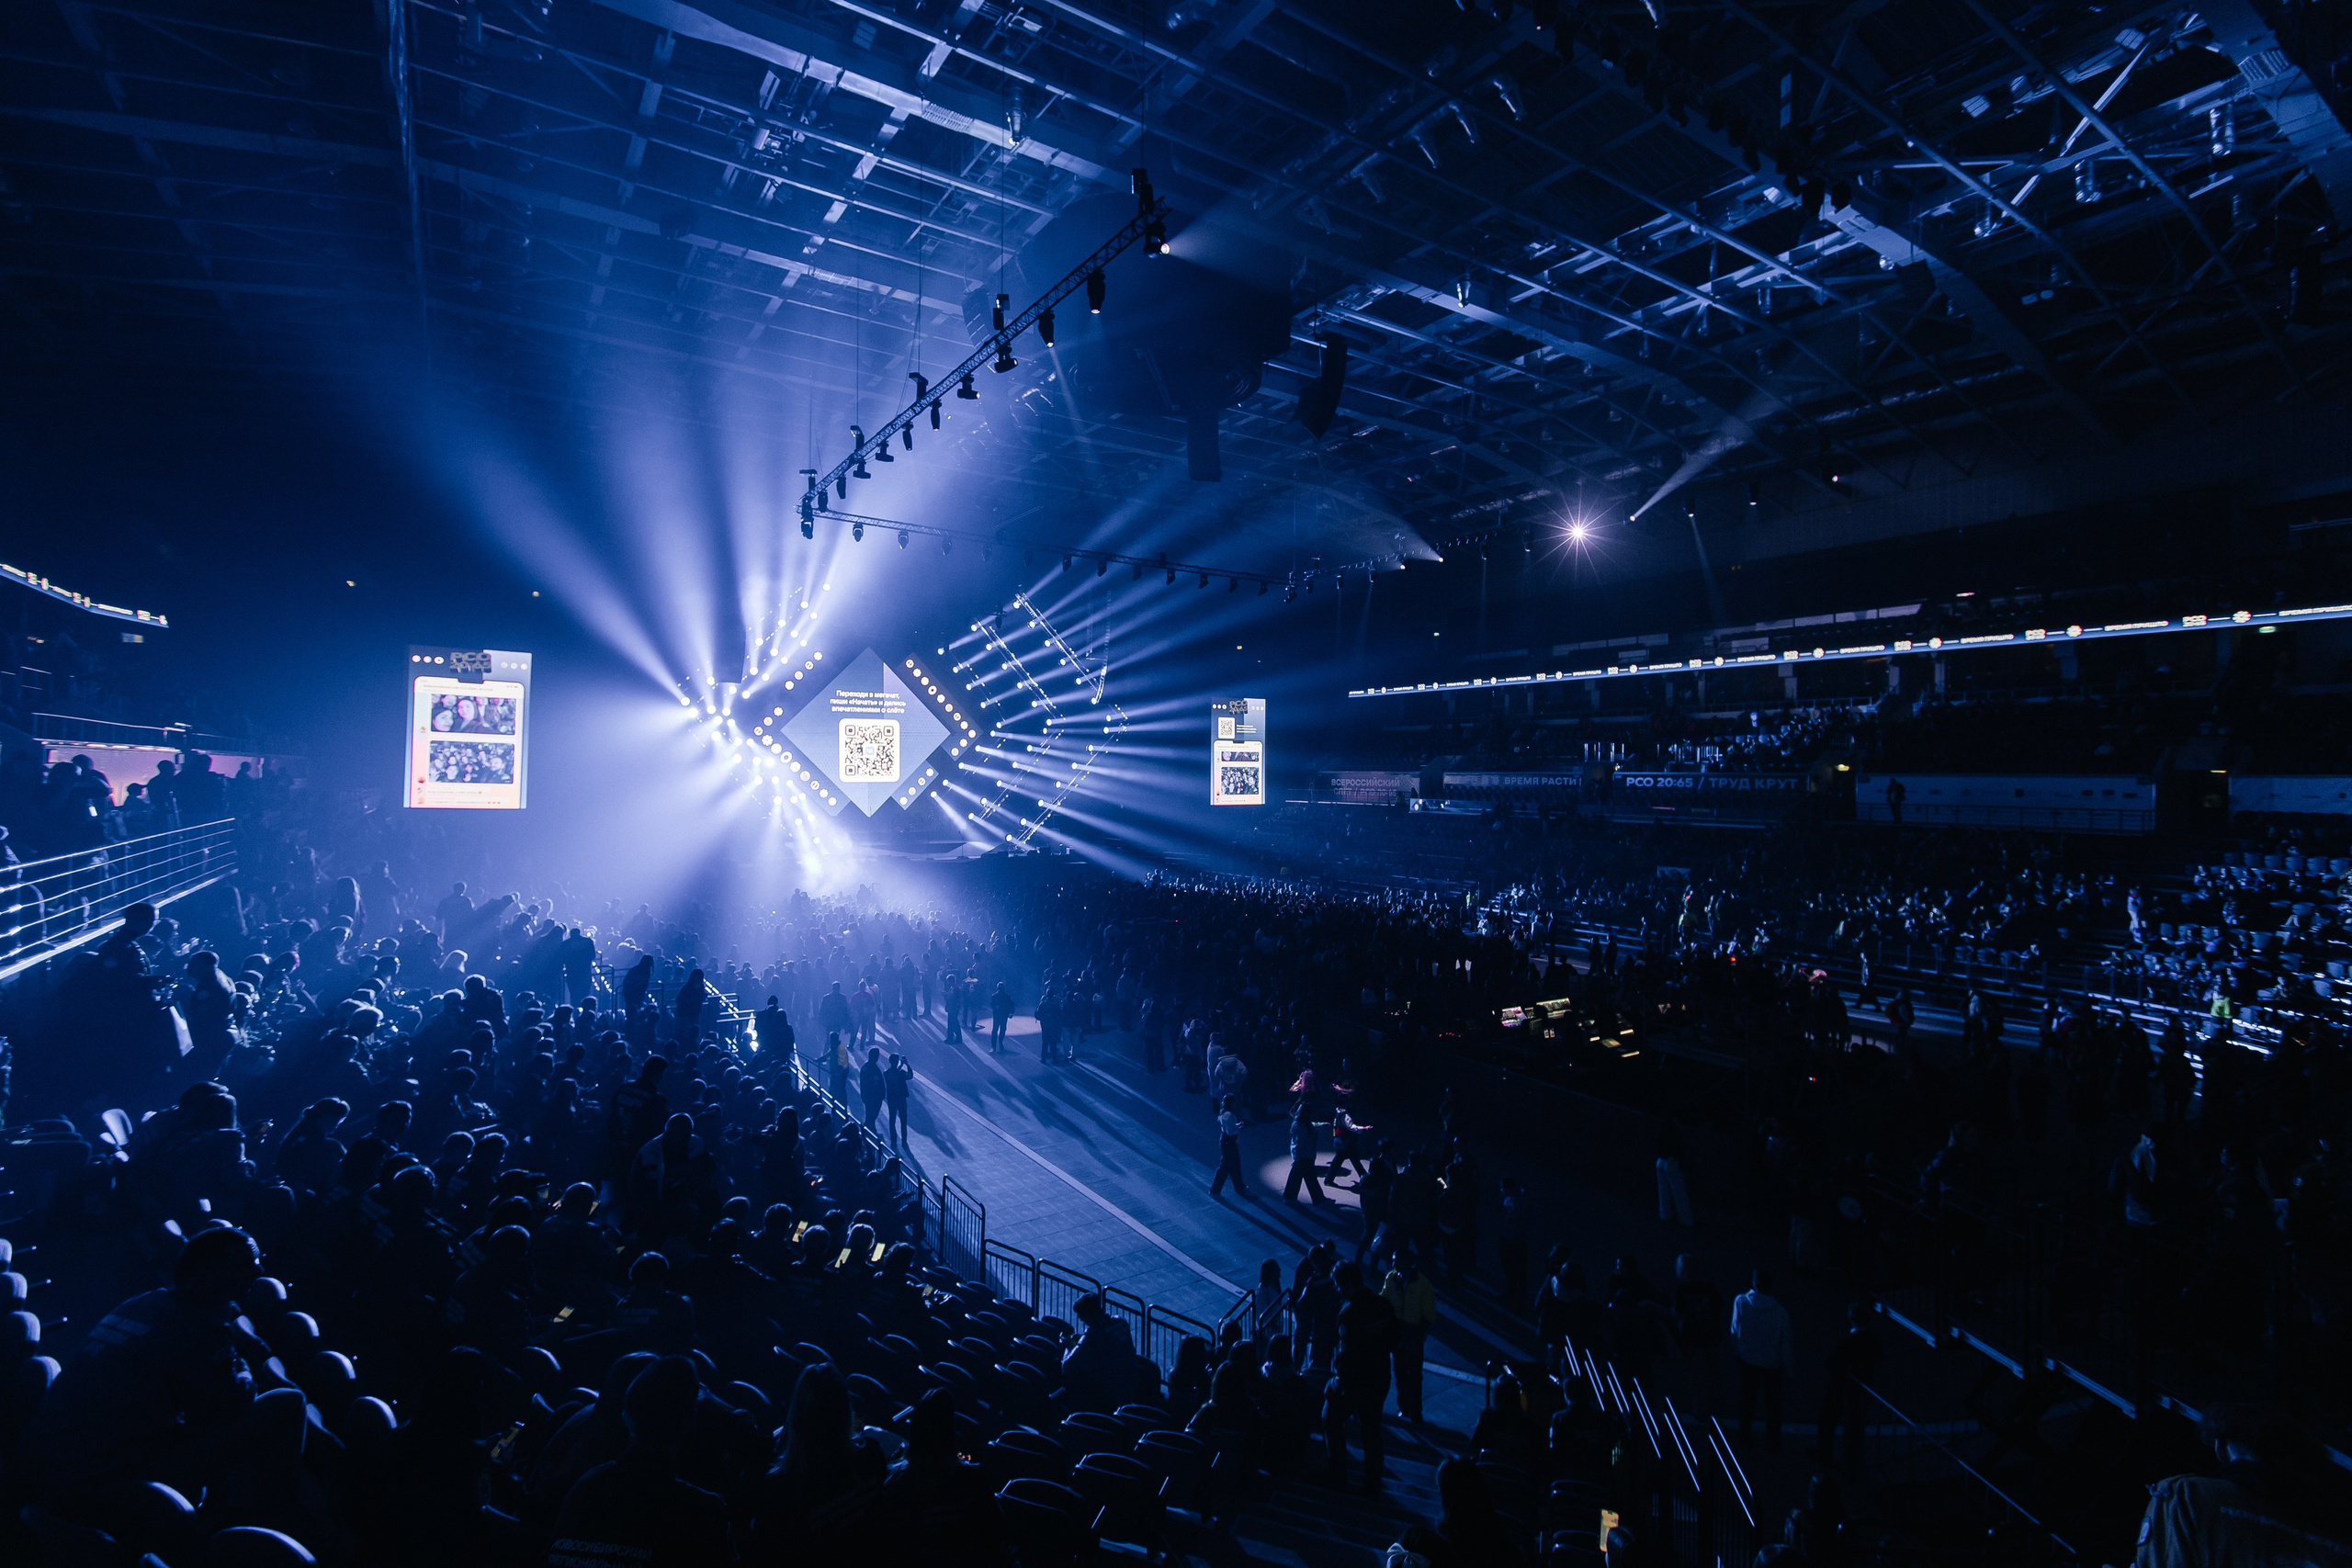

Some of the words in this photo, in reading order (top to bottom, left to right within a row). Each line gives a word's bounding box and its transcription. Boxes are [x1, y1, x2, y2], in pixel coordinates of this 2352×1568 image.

[836, 690, 868, 698] Переходи
[1331, 776, 1400, 787] ВСЕРОССИЙСКИЙ
[1504, 777, 1539, 785] ВРЕМЯ
[1542, 777, 1577, 786] РАСТИ
[1626, 777, 1654, 787] РСО
[1657, 777, 1693, 787] 20:65
[1709, 778, 1751, 791] ТРУД
[1755, 778, 1797, 790] КРУТ
